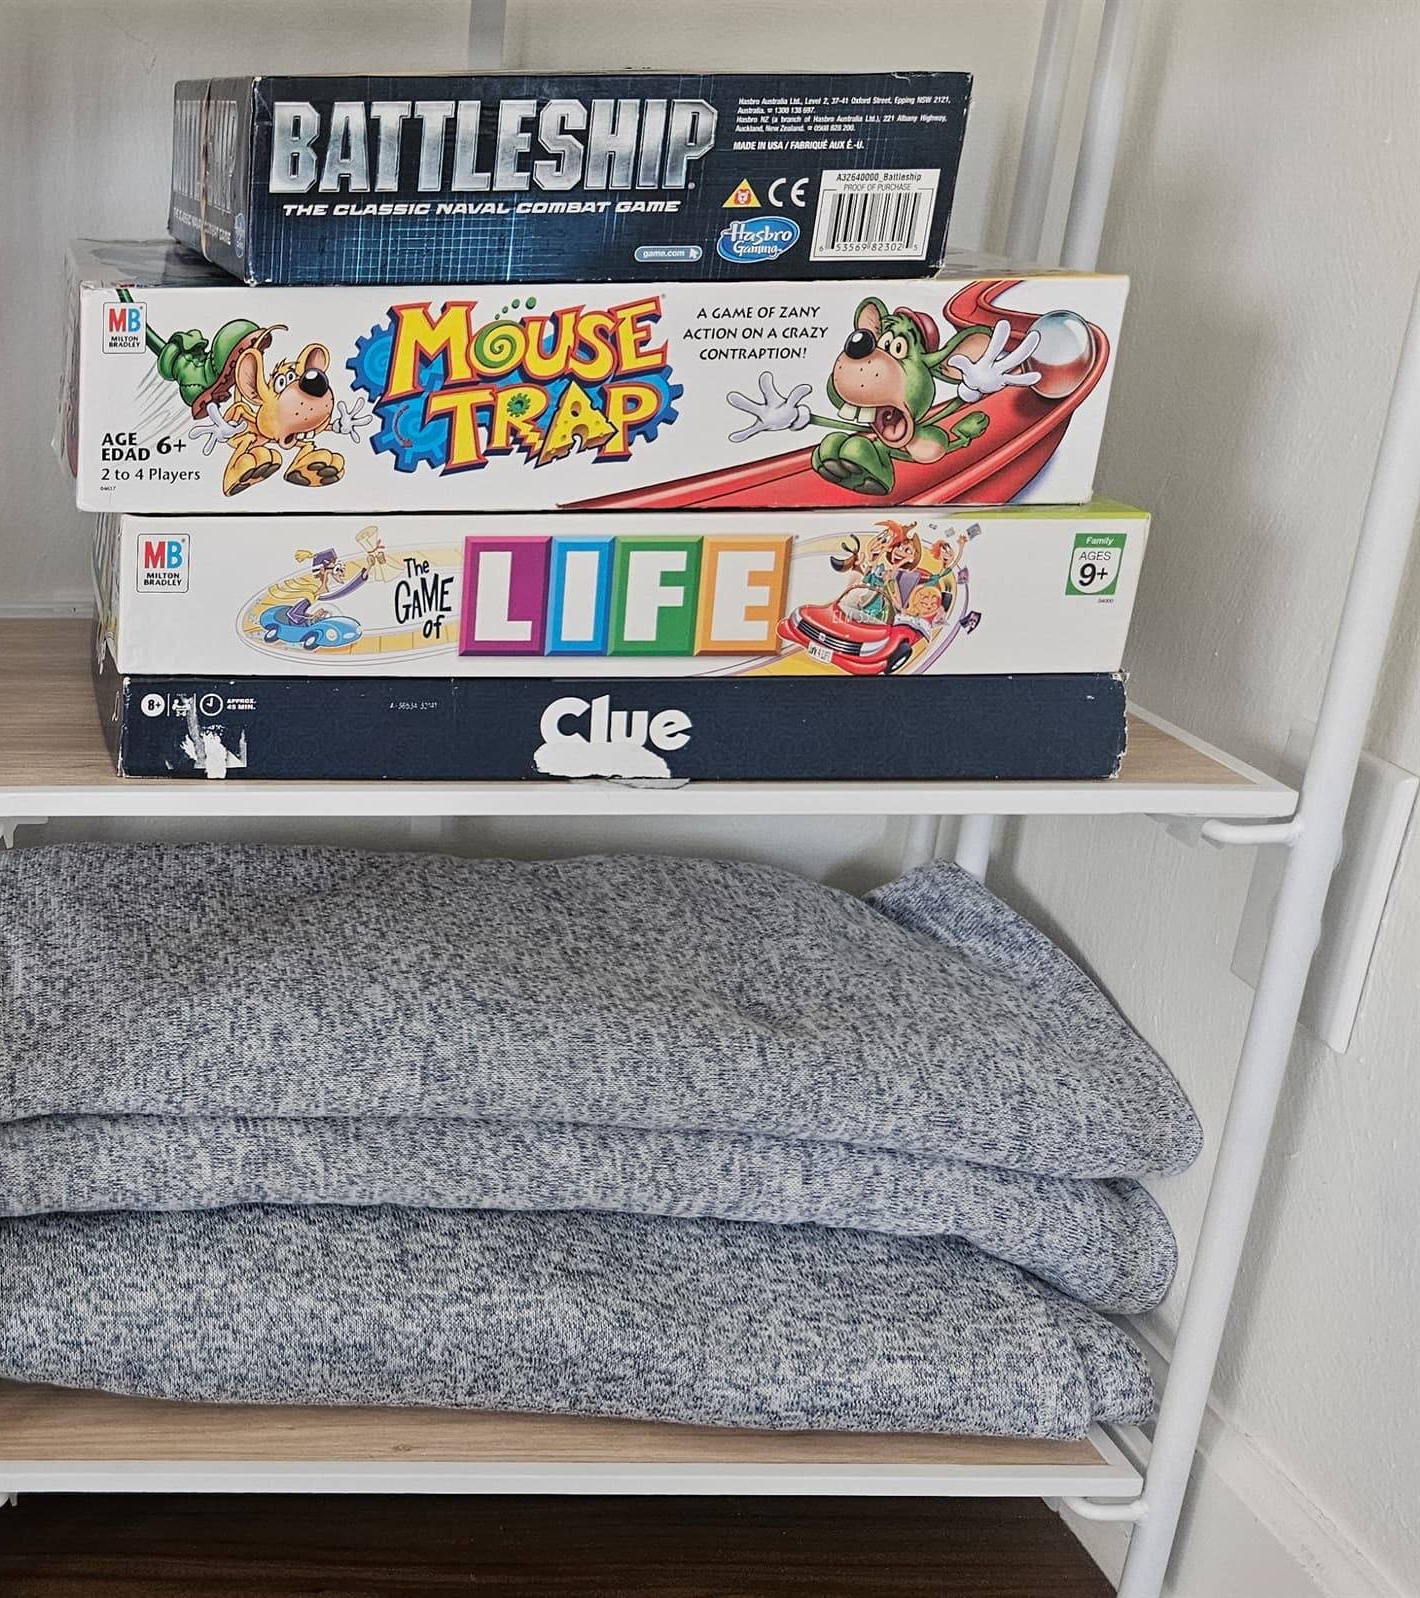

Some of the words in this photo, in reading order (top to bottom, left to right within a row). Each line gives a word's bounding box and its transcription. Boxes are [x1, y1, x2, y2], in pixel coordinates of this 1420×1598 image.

[269, 98, 718, 194] BATTLESHIP
[733, 141, 757, 150] MADE
[758, 142, 766, 150] IN
[768, 141, 784, 150] USA
[828, 141, 846, 150] AUX
[844, 183, 866, 191] PROOF
[878, 183, 912, 191] PURCHASE
[283, 204, 328, 216] THE
[332, 204, 430, 216] CLASSIC
[436, 203, 511, 215] NAVAL
[515, 202, 612, 214] COMBAT
[616, 201, 681, 214] GAME
[722, 220, 793, 243] Hasbro
[643, 249, 685, 258] game.com
[733, 240, 783, 258] Gaming
[836, 242, 869, 252] 53569
[870, 242, 903, 252] 82302
[108, 308, 141, 332] MB
[697, 308, 710, 319] A
[712, 307, 748, 319] GAME
[752, 306, 777, 318] OF
[780, 306, 821, 318] ZANY
[683, 328, 739, 339] ACTION
[742, 328, 766, 339] ON
[771, 328, 784, 339] A
[787, 326, 828, 339] CRAZY
[380, 296, 669, 404] MOUSE
[700, 346, 807, 360] CONTRAPTION!
[426, 378, 660, 476] TRAP
[102, 432, 138, 446] AGE
[156, 436, 187, 455] 6+
[101, 448, 151, 461] EDAD
[101, 468, 113, 481] 2
[115, 468, 131, 481] to
[134, 468, 144, 481] 4
[149, 468, 200, 484] Players
[1086, 536, 1114, 546] Family
[144, 541, 182, 569] MB
[1079, 552, 1111, 561] AGES
[404, 558, 430, 579] The
[1079, 563, 1108, 588] 9+
[394, 574, 454, 624] GAME
[473, 550, 776, 642] LIFE
[423, 615, 445, 639] of
[148, 700, 161, 710] 8+
[540, 694, 693, 752] Clue
